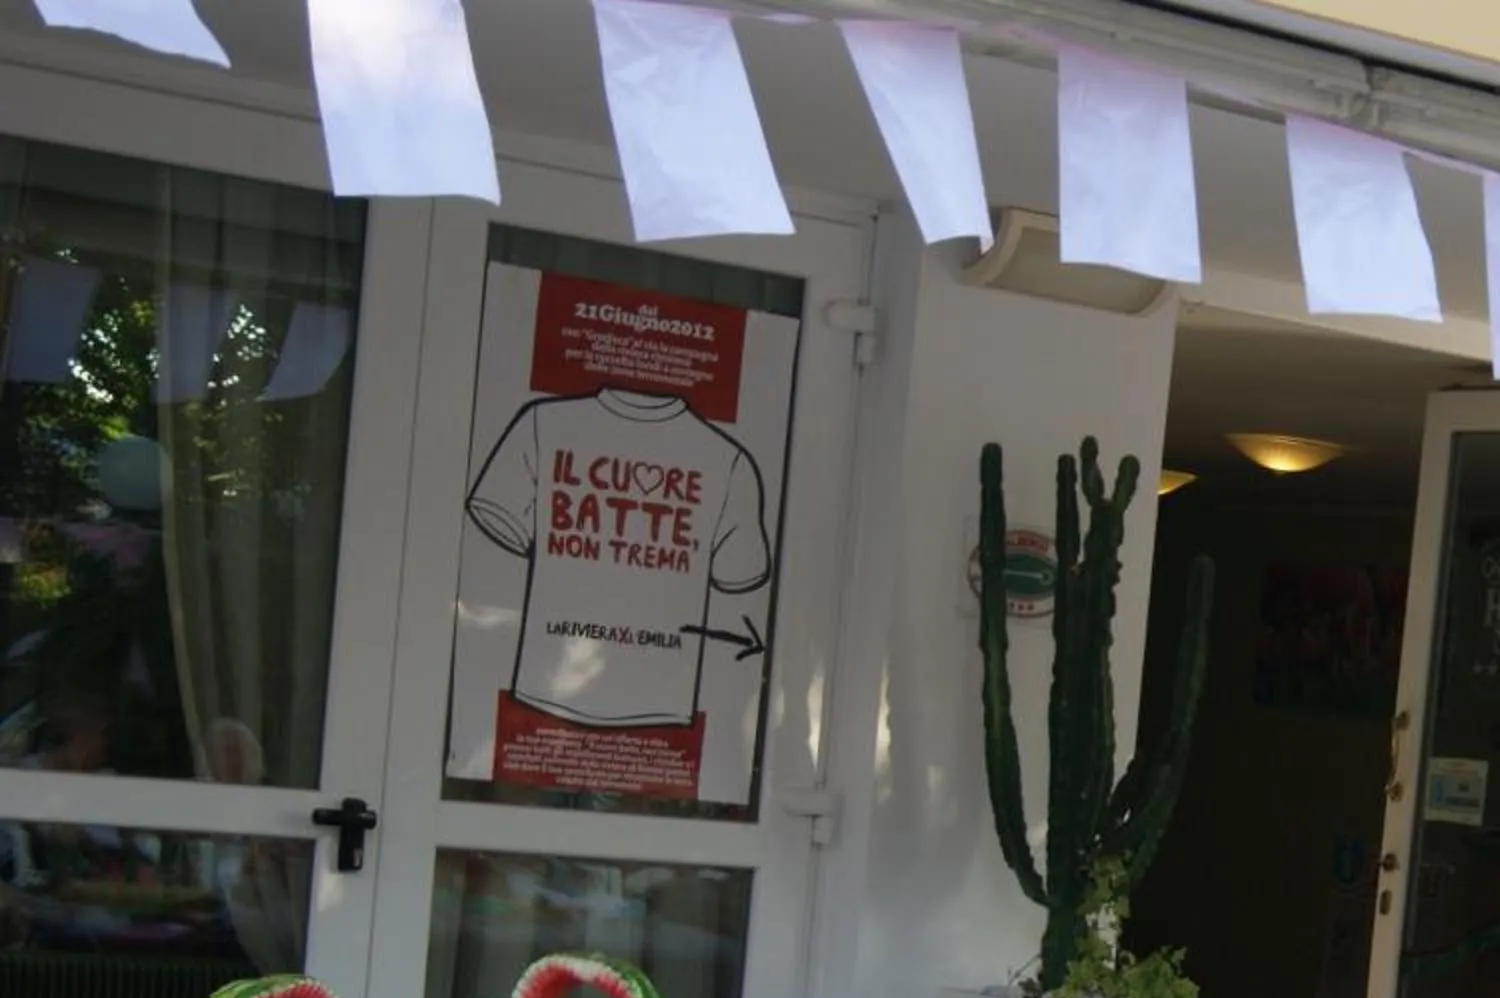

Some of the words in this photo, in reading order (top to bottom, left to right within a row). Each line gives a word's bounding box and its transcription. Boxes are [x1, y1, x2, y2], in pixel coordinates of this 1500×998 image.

[553, 449, 581, 486] IL
[551, 490, 699, 551] BATTE,
[548, 532, 600, 561] NON
[608, 540, 690, 573] TREMA
